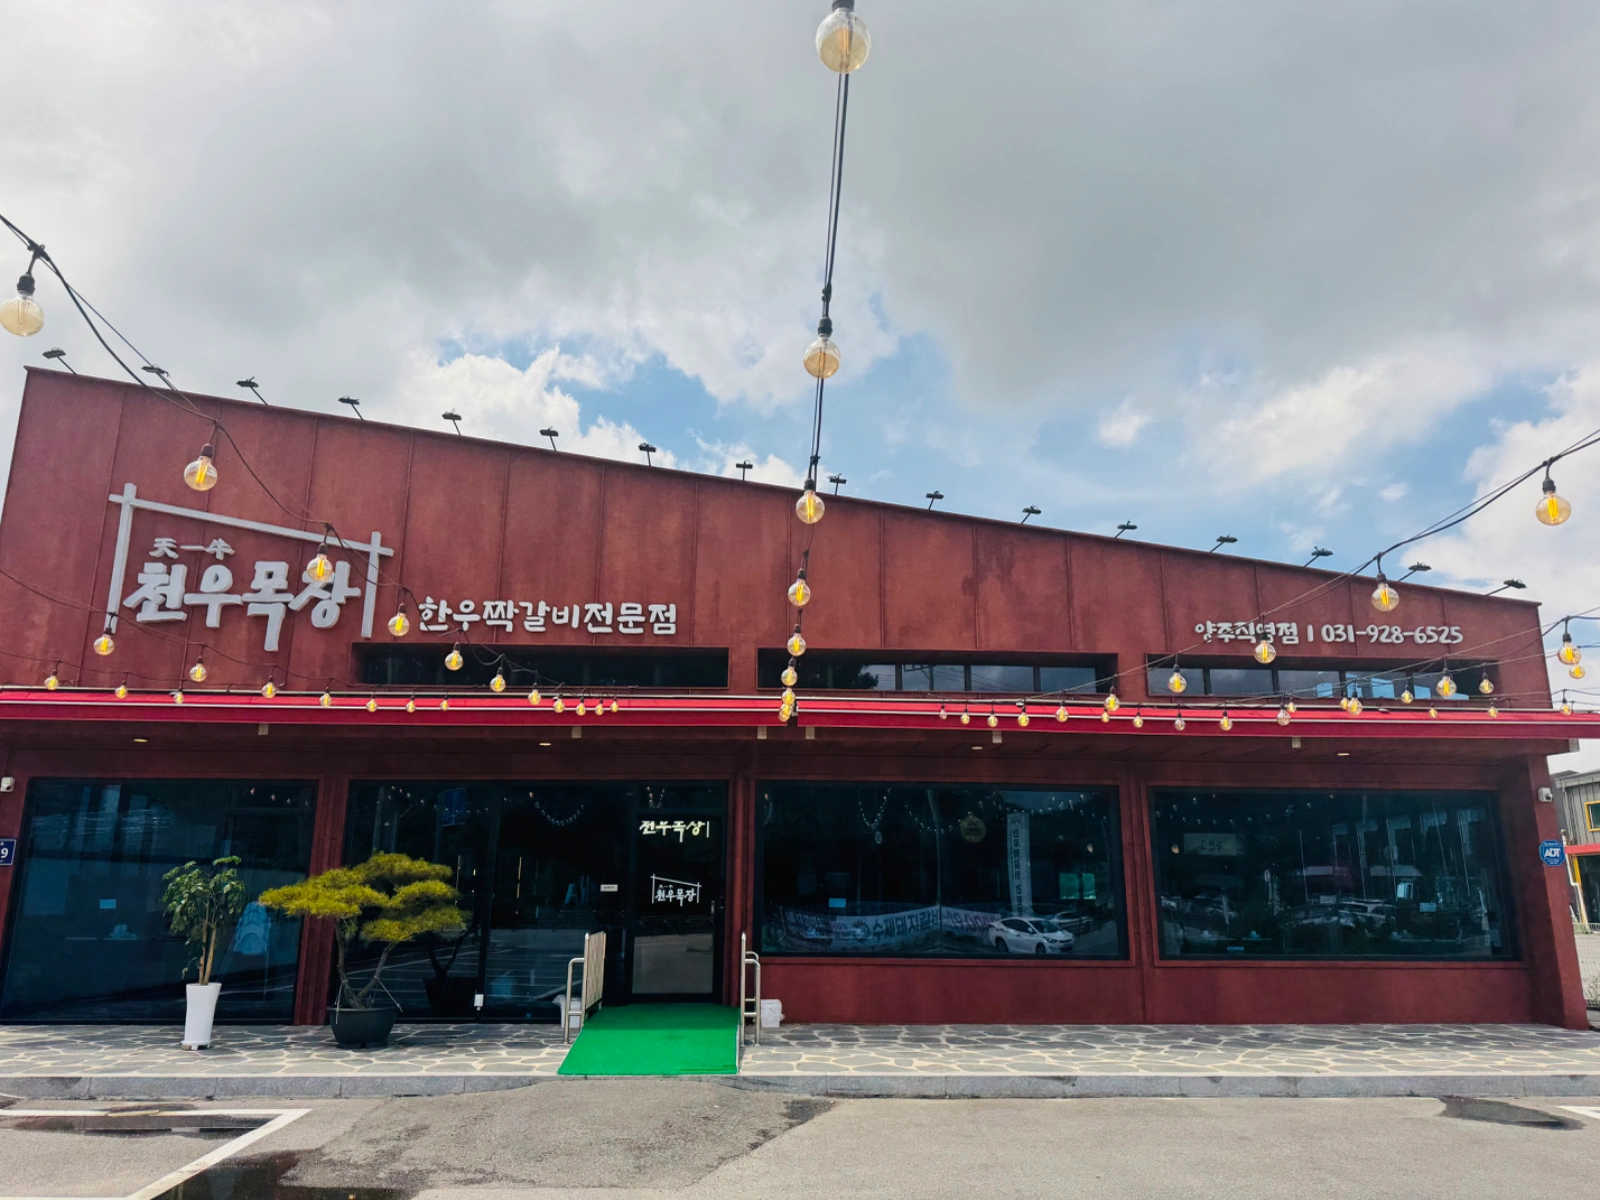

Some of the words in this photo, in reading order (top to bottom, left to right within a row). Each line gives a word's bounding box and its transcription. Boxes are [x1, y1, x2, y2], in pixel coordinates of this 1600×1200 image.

[123, 561, 361, 652] 천우목장
[418, 596, 677, 635] 한우짝갈비전문점
[1194, 620, 1300, 645] 양주직영점
[1321, 623, 1464, 644] 031-928-6525
[1544, 847, 1561, 858] ADT
